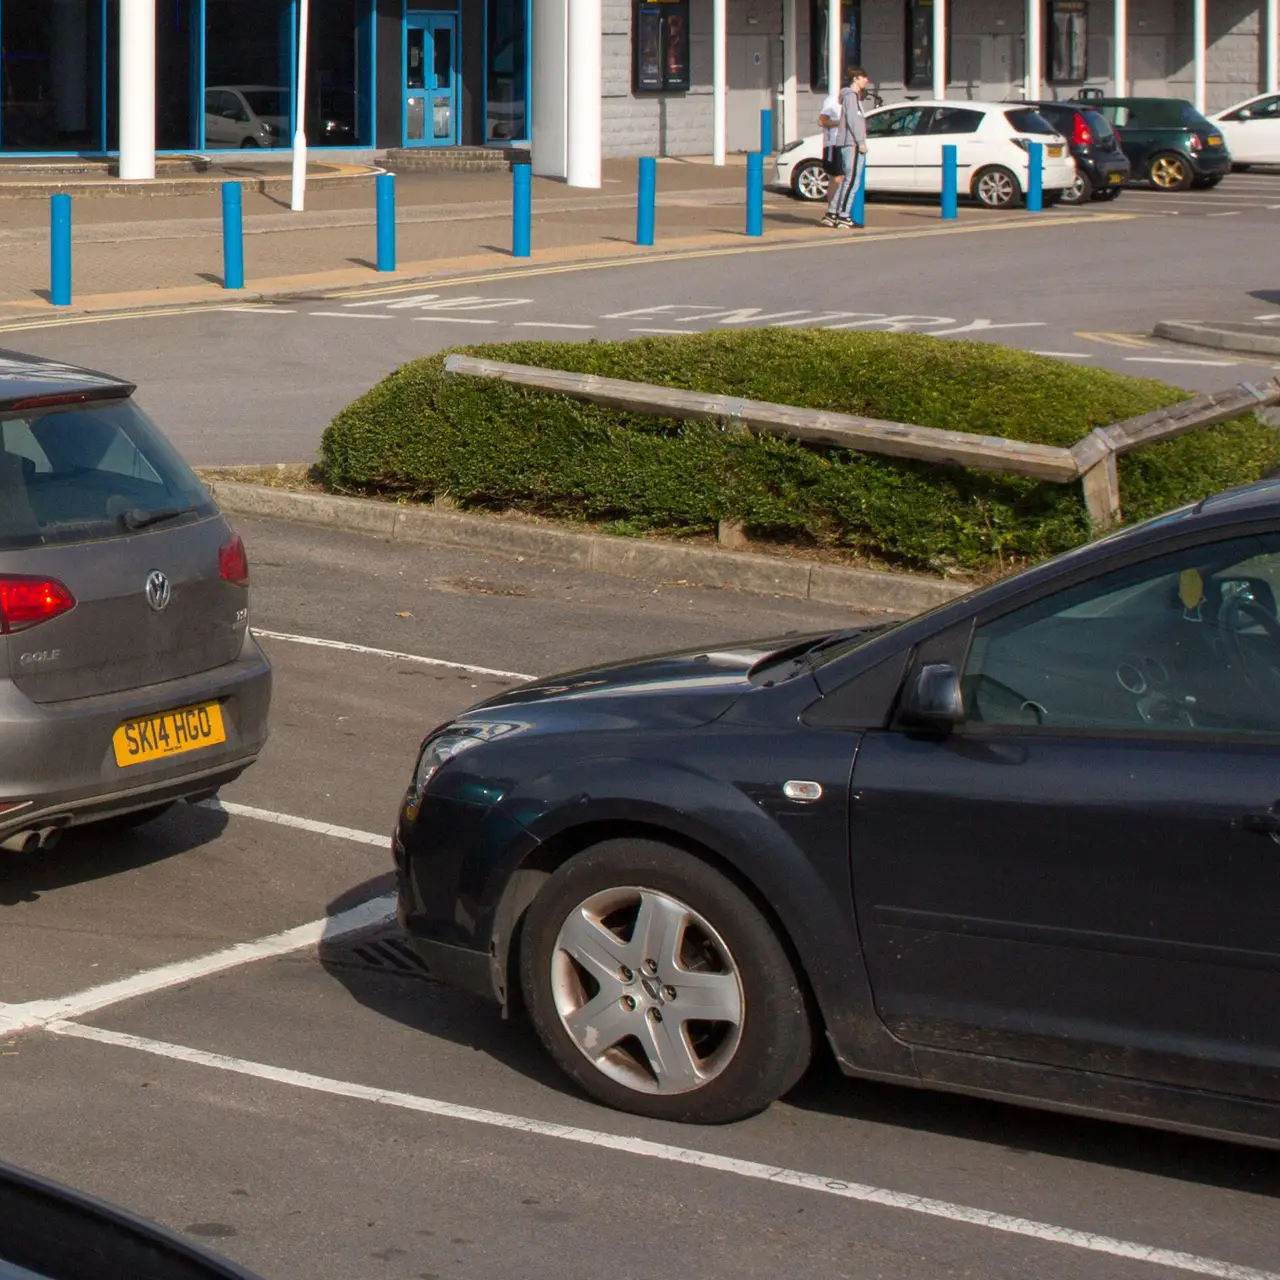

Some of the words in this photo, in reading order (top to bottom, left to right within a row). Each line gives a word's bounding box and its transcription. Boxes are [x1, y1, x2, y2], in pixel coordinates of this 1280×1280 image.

[341, 294, 535, 310] NO
[599, 304, 1047, 336] ENTRY
[20, 649, 61, 665] GOLF
[124, 713, 170, 756] SK14
